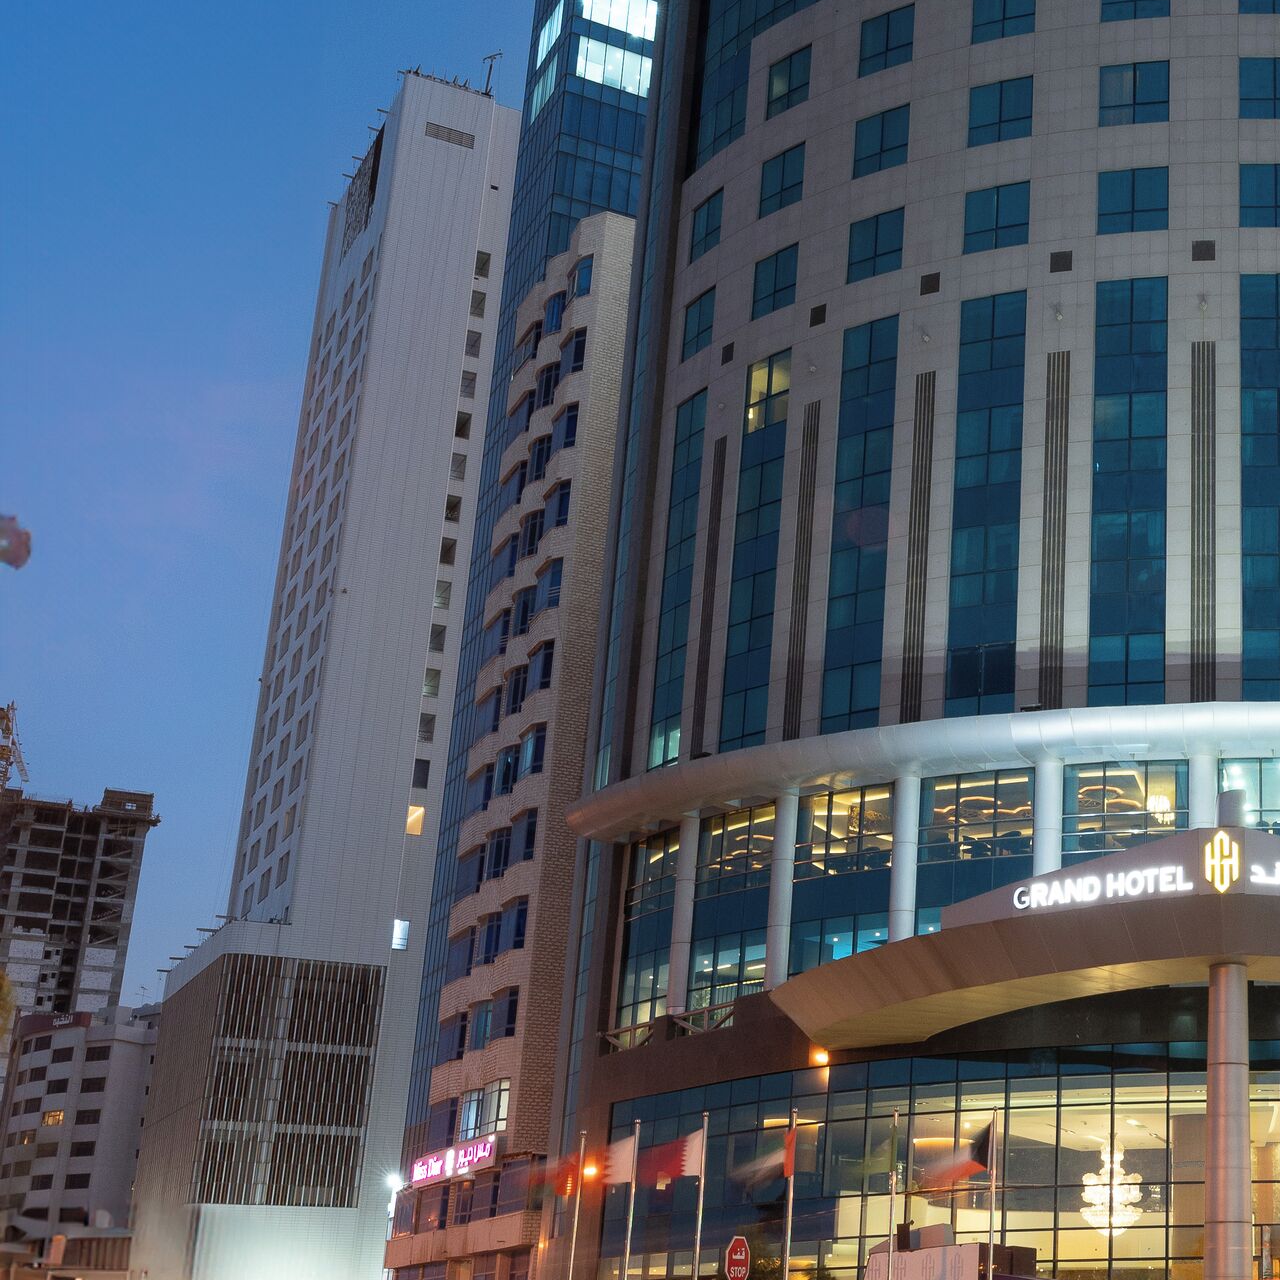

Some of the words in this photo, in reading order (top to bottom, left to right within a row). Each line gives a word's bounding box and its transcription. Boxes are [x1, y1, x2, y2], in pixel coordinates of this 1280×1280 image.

[1013, 875, 1101, 910] GRAND
[1106, 866, 1193, 898] HOTEL
[730, 1266, 746, 1278] STOP
